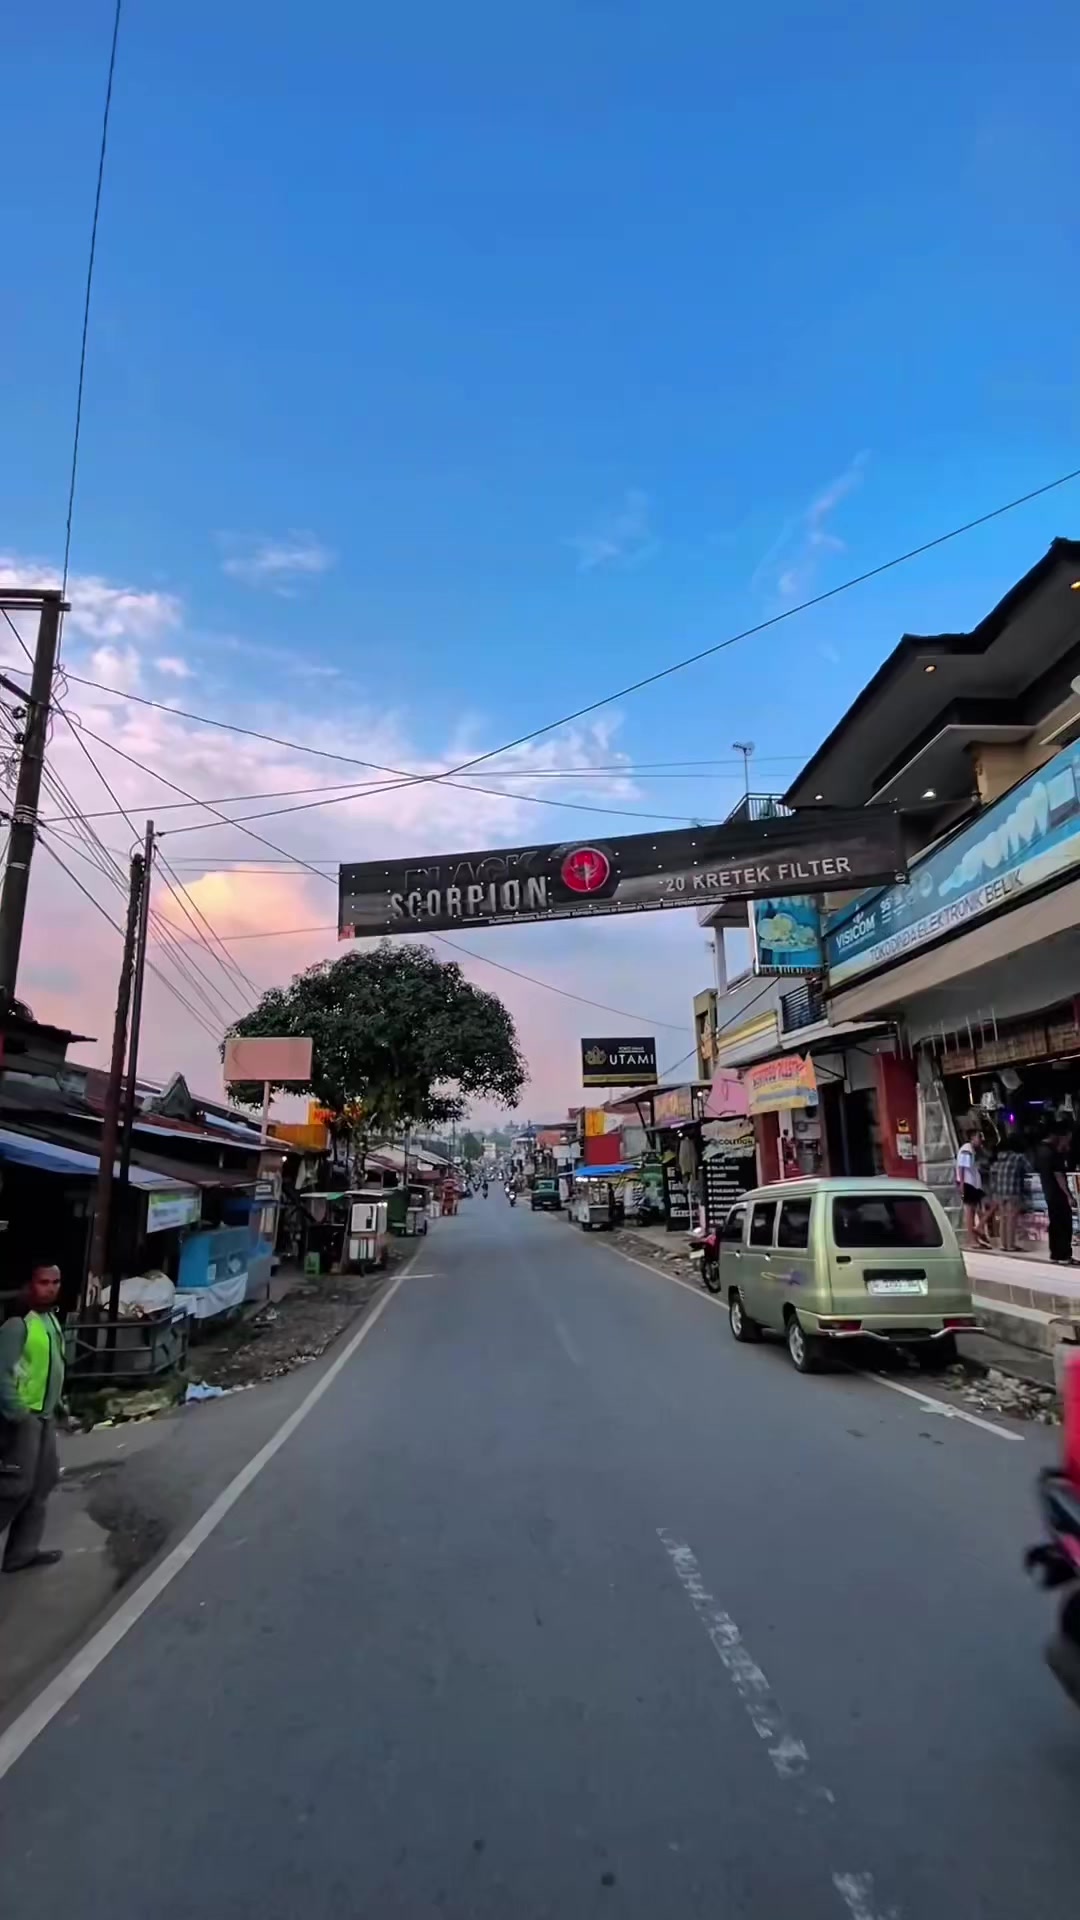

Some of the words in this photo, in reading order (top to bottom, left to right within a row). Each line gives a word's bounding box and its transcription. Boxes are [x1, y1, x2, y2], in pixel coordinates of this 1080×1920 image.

[665, 877, 685, 893] 20
[692, 864, 771, 889] KRETEK
[777, 856, 852, 881] FILTER
[390, 876, 548, 921] SCORPION
[835, 913, 876, 949] VISICOM
[609, 1053, 654, 1065] UTAMI
